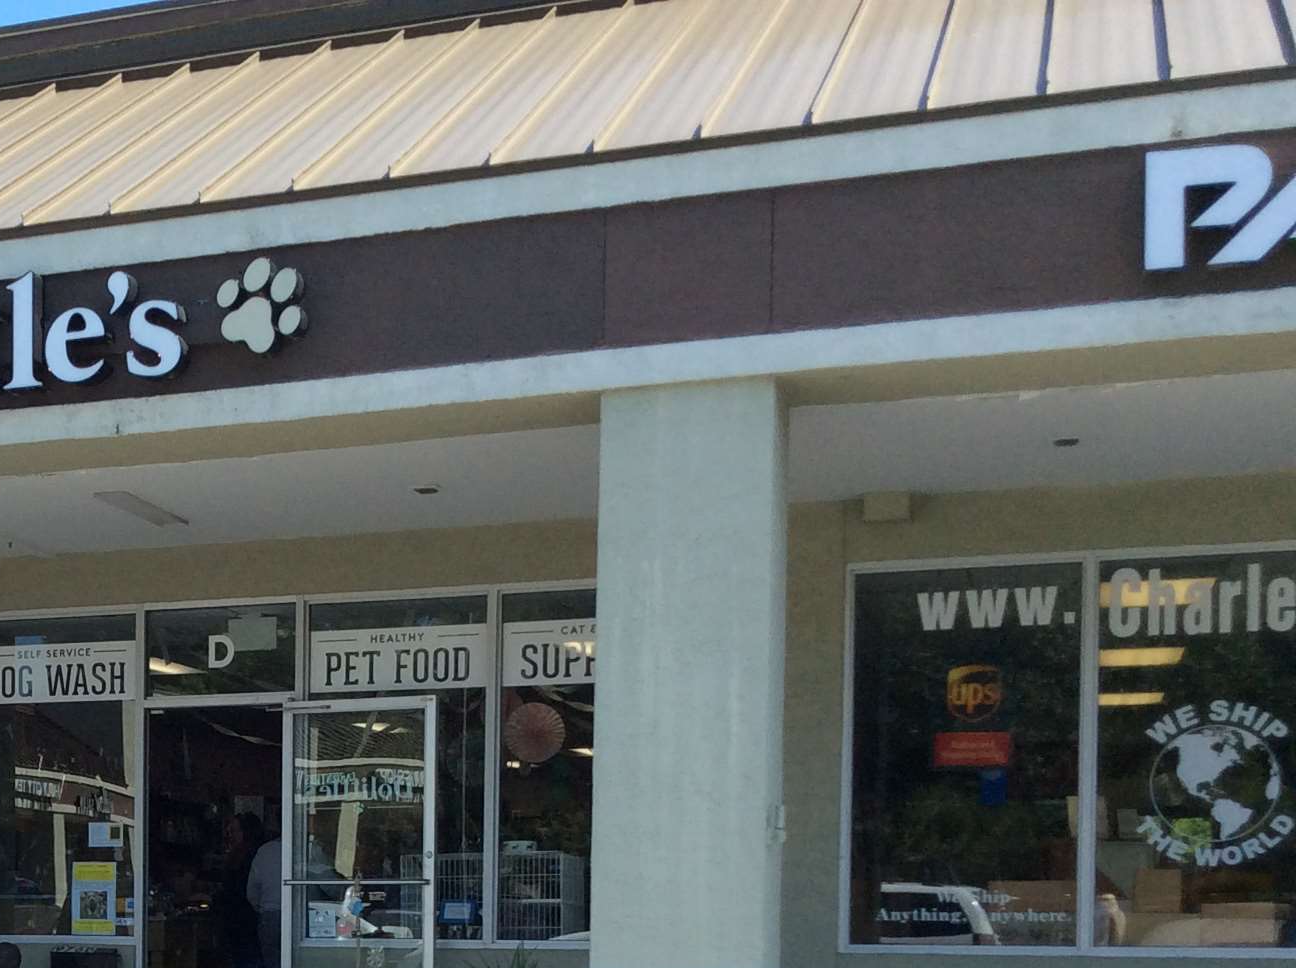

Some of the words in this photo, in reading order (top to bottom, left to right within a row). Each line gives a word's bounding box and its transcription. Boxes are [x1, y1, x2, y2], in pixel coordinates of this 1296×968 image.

[917, 585, 1076, 632] www.
[1107, 562, 1296, 638] Charle
[370, 632, 425, 645] HEALTHY
[560, 624, 586, 635] CAT
[16, 649, 42, 660] SELF
[45, 647, 92, 659] SERVICE
[207, 634, 236, 669] D
[324, 650, 381, 687] PET
[394, 646, 471, 684] FOOD
[45, 661, 127, 697] WASH
[949, 682, 998, 715] ups
[1145, 704, 1201, 744] WE
[1208, 699, 1289, 738] SHIP
[1135, 815, 1190, 863] THE
[1194, 814, 1295, 867] WORLD
[985, 908, 1072, 925] nywhere.
